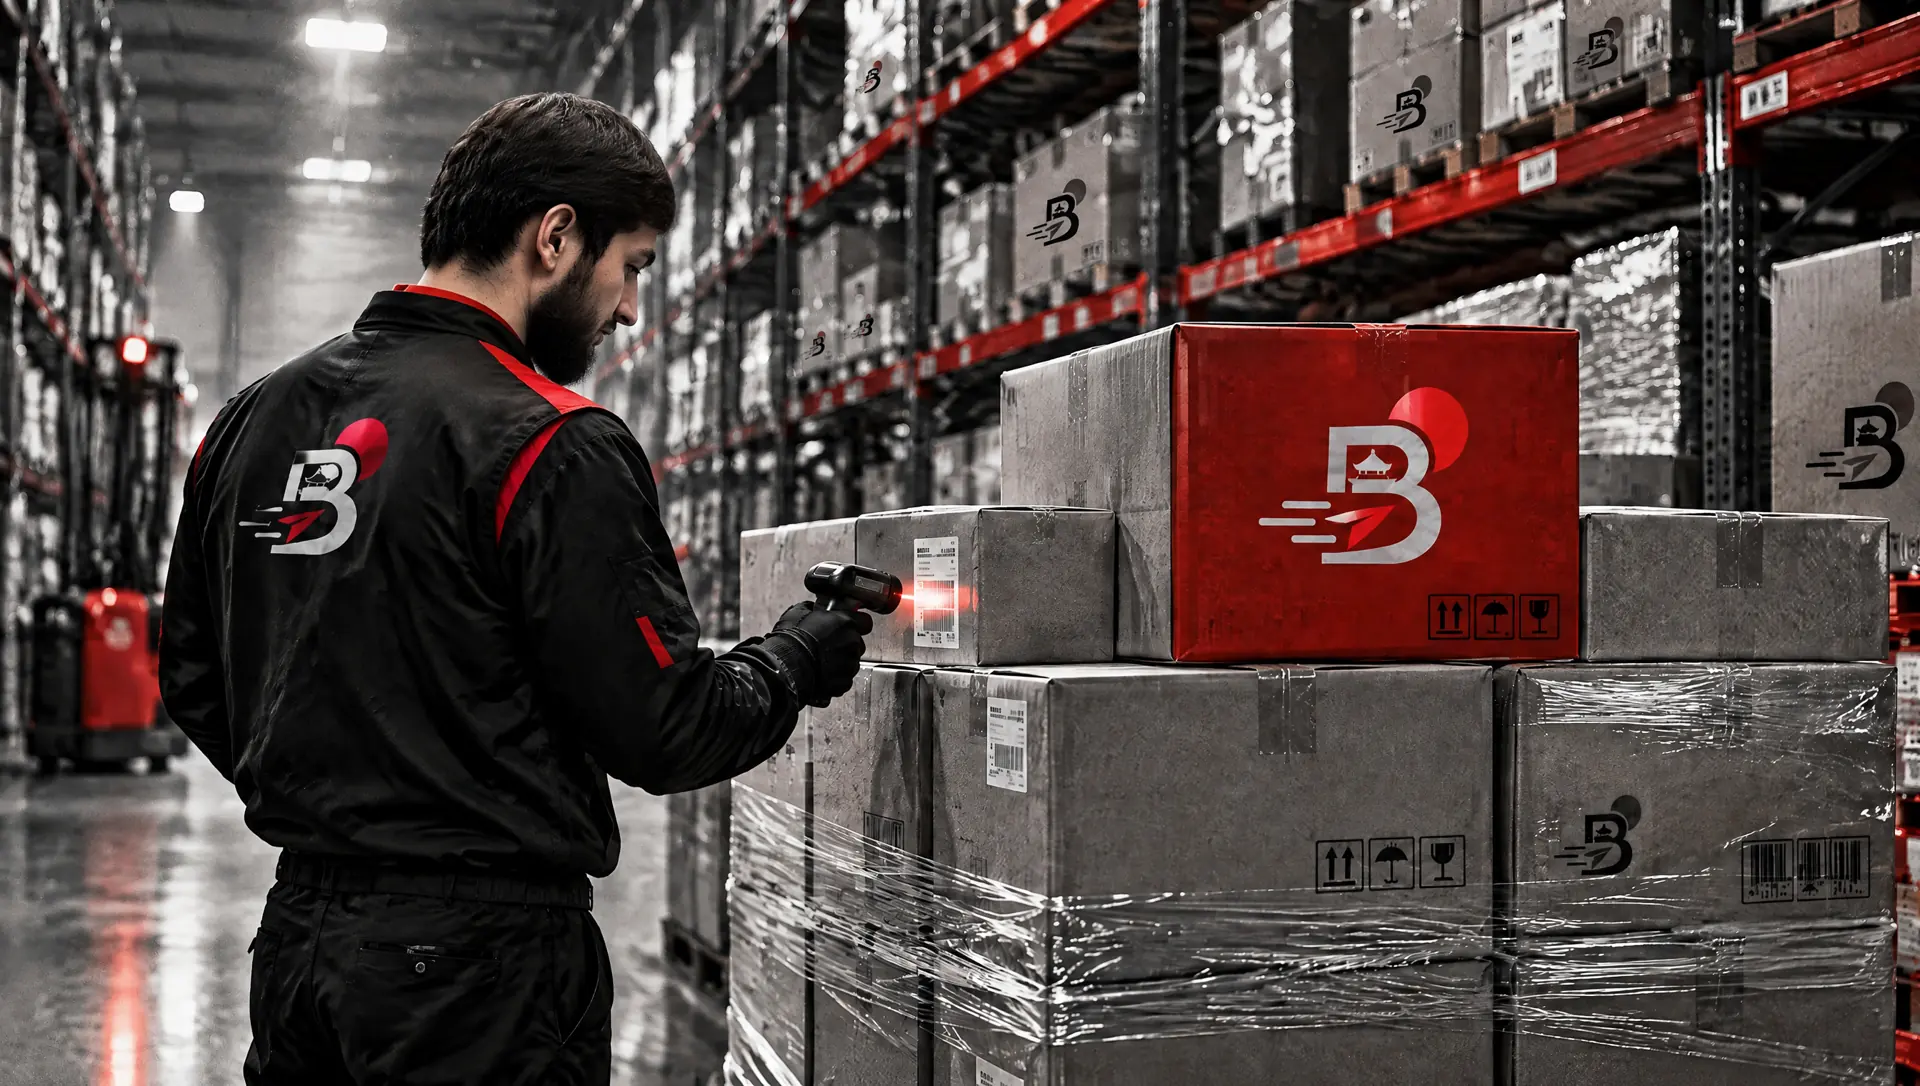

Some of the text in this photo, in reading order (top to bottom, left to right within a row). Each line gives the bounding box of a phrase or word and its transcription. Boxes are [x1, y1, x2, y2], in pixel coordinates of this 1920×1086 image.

[1393, 89, 1426, 134] B
[1043, 194, 1079, 247] B
[1839, 405, 1905, 490] B
[270, 449, 357, 555] B
[1321, 425, 1442, 564] B
[1581, 814, 1632, 875] B
